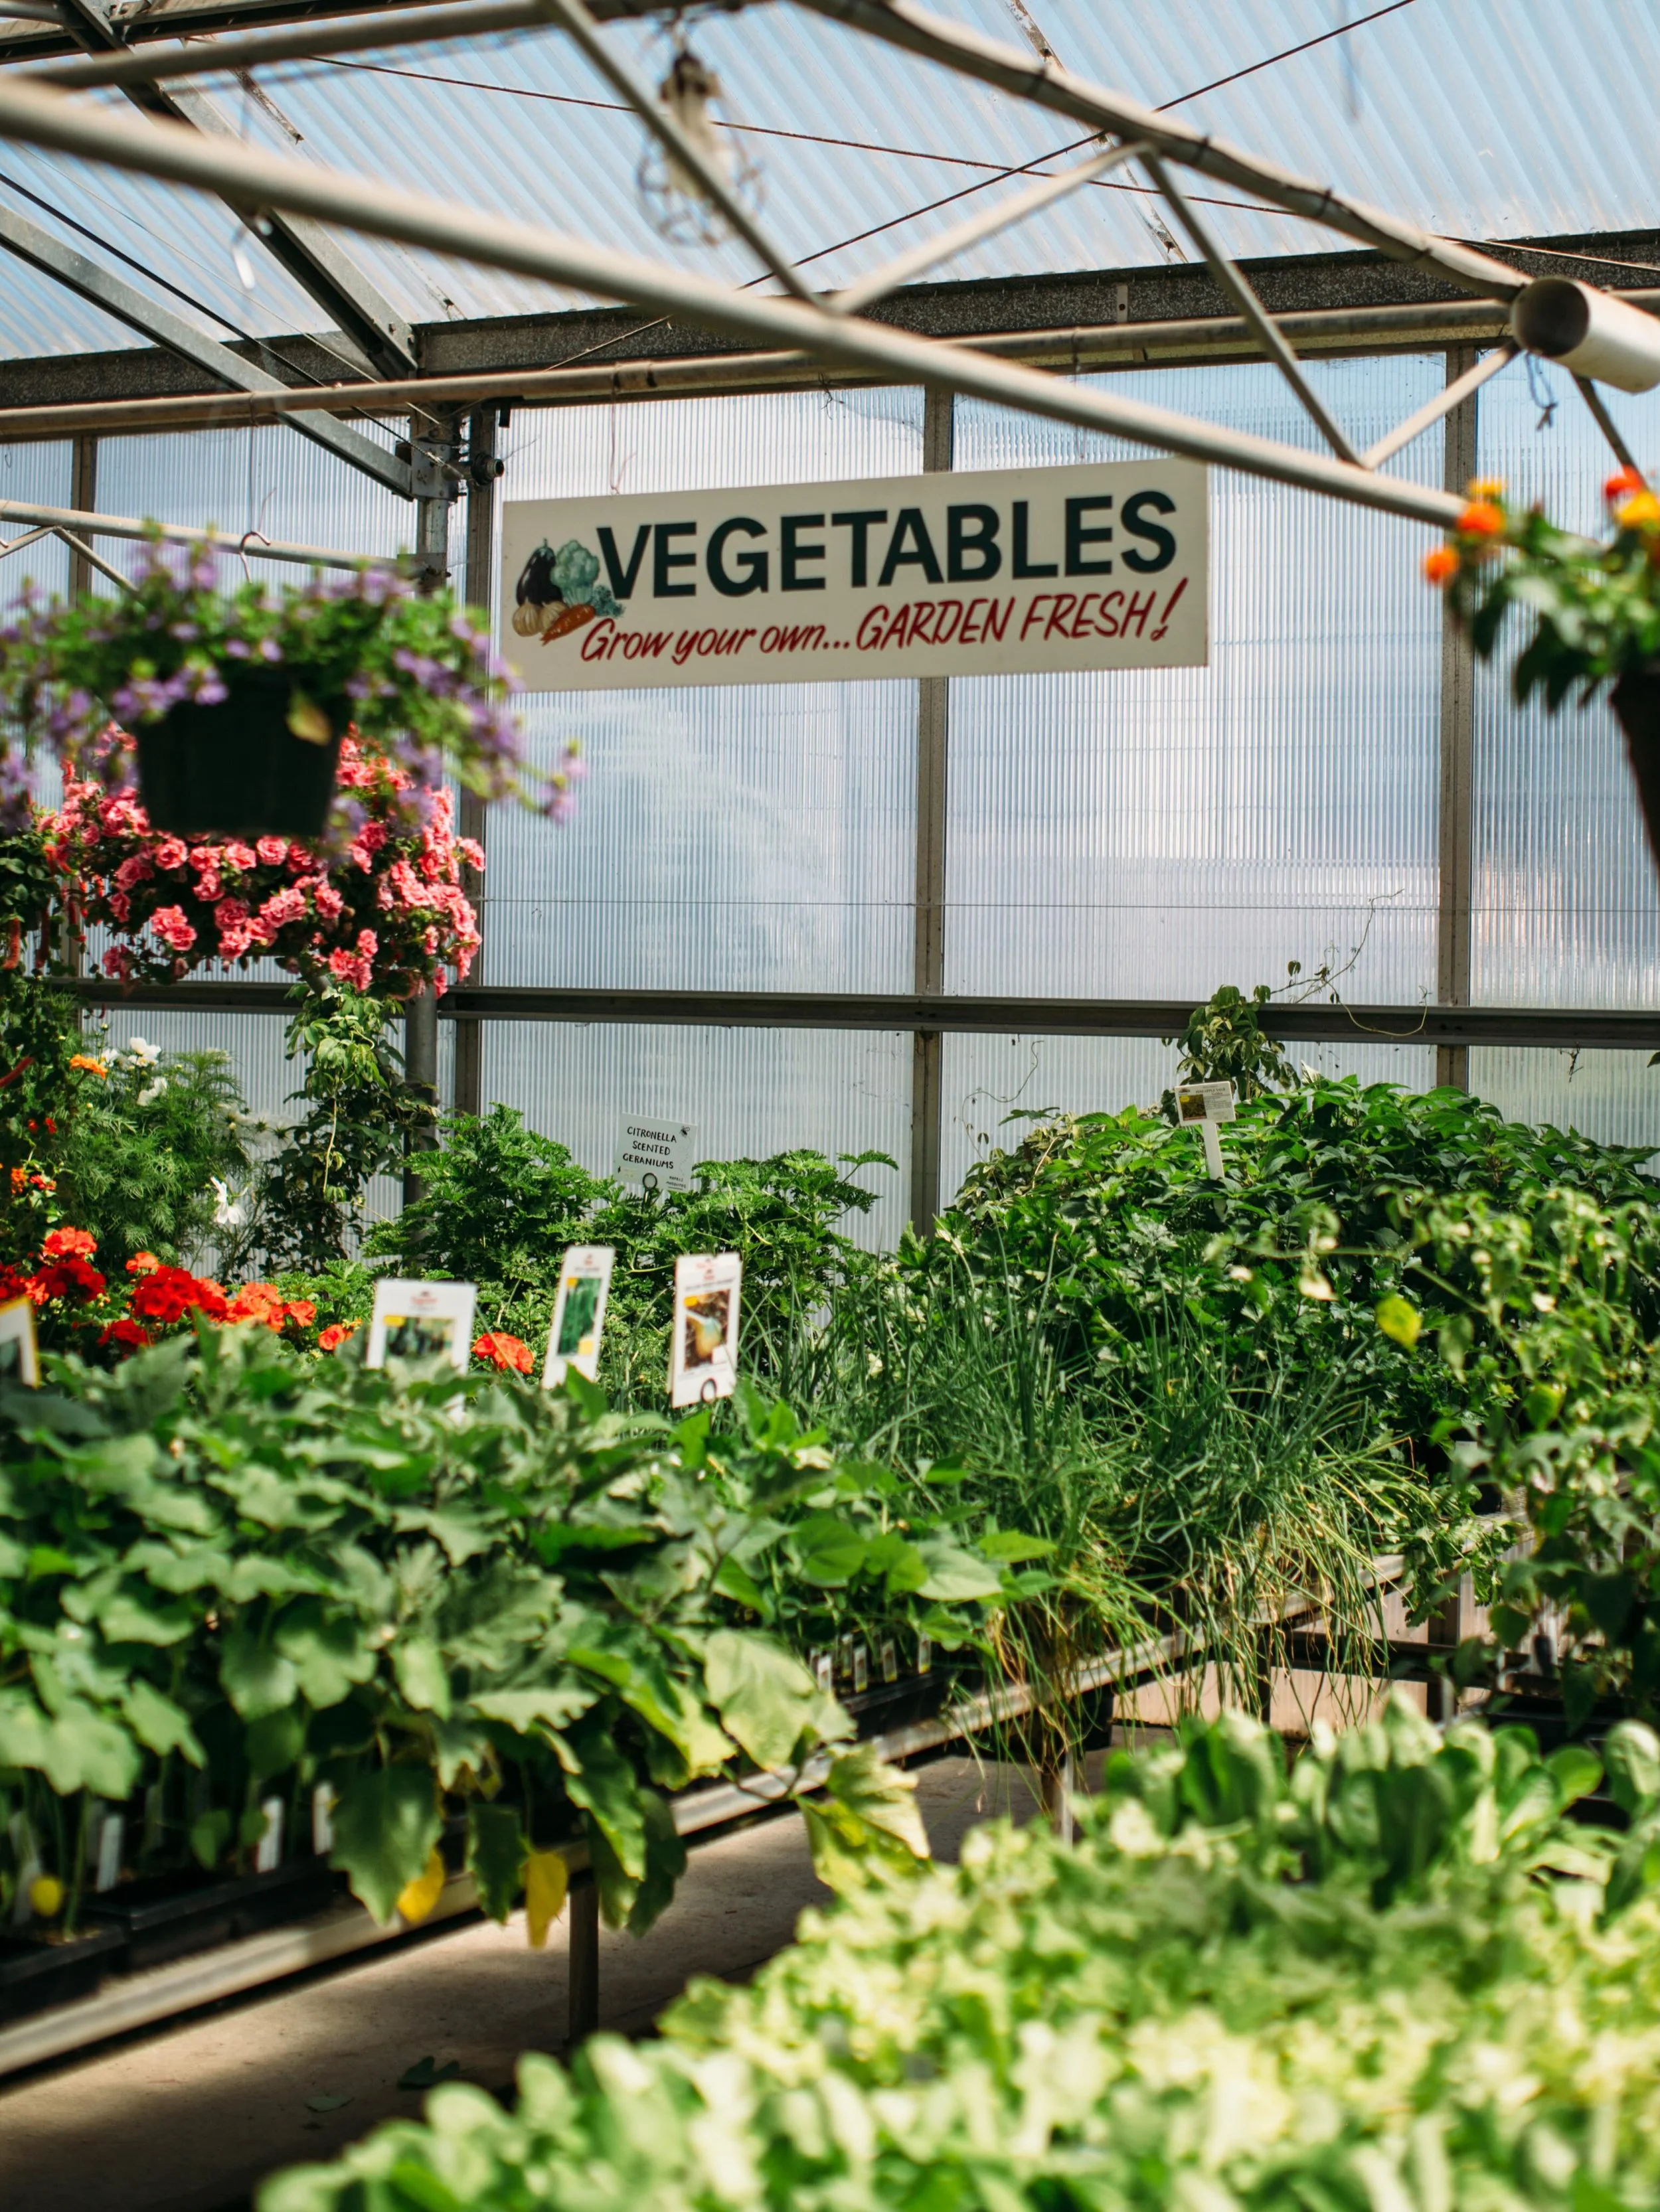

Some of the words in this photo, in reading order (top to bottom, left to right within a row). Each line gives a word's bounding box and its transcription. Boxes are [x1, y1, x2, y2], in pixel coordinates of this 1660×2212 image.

[596, 490, 1177, 600] VEGETABLES
[581, 618, 674, 662] Grow
[671, 628, 758, 666] your
[856, 597, 1016, 651] GARDEN
[1019, 578, 1188, 641] FRESH!
[627, 1126, 677, 1143] CITRONELLA
[632, 1141, 671, 1156] SCENTED
[622, 1152, 674, 1169] GERANIUMS
